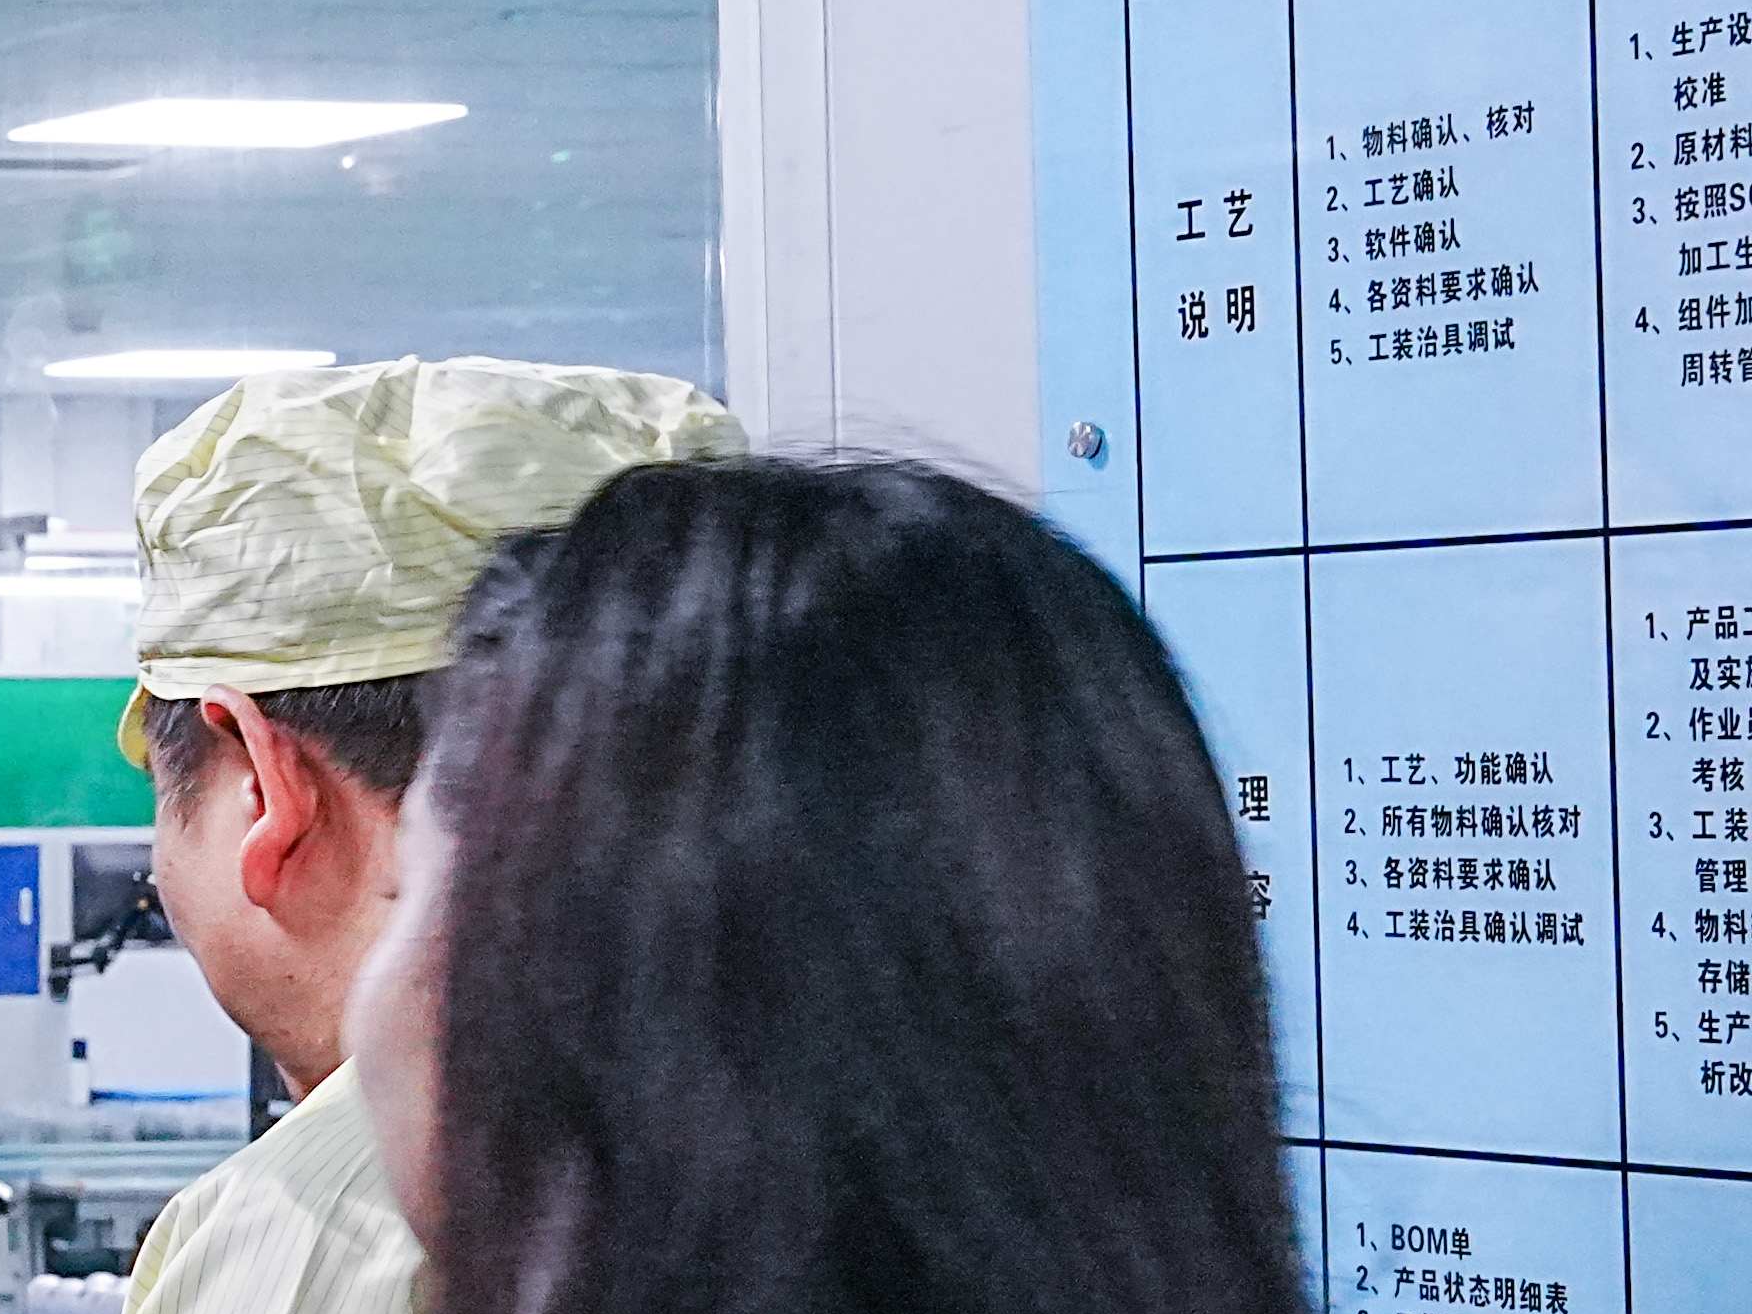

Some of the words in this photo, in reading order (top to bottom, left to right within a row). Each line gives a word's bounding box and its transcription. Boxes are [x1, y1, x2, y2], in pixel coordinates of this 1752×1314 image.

[1673, 71, 1727, 112] 校准
[1326, 100, 1535, 161] 1、物料确认、核对
[1326, 165, 1459, 212] 2、工艺确认
[1632, 182, 1752, 225] 3、按照S
[1176, 188, 1254, 242] 工艺
[1327, 217, 1461, 263] 3、软件确认
[1328, 261, 1539, 314] 4、各资料要求确认
[1177, 285, 1255, 340] 说明
[1330, 316, 1515, 366] 5、工装治具调试
[1689, 654, 1752, 692] 及实
[1646, 706, 1752, 743] 2、作业
[1343, 751, 1554, 785] 1、工艺、功能确认
[1692, 756, 1745, 793] 考核
[1237, 775, 1271, 822] 理
[1344, 804, 1581, 839] 2、所有物料确认核对
[1649, 807, 1749, 843] 3、工装
[1345, 856, 1557, 892] 3、各资料要求确认
[1695, 857, 1749, 894] 管理
[1346, 908, 1585, 947] 4、工装治具确认调试
[1651, 907, 1752, 945] 4、物料
[1697, 958, 1751, 996] 存储
[1654, 1009, 1751, 1045] 5、生产
[1356, 1222, 1472, 1261] 1、BOM单
